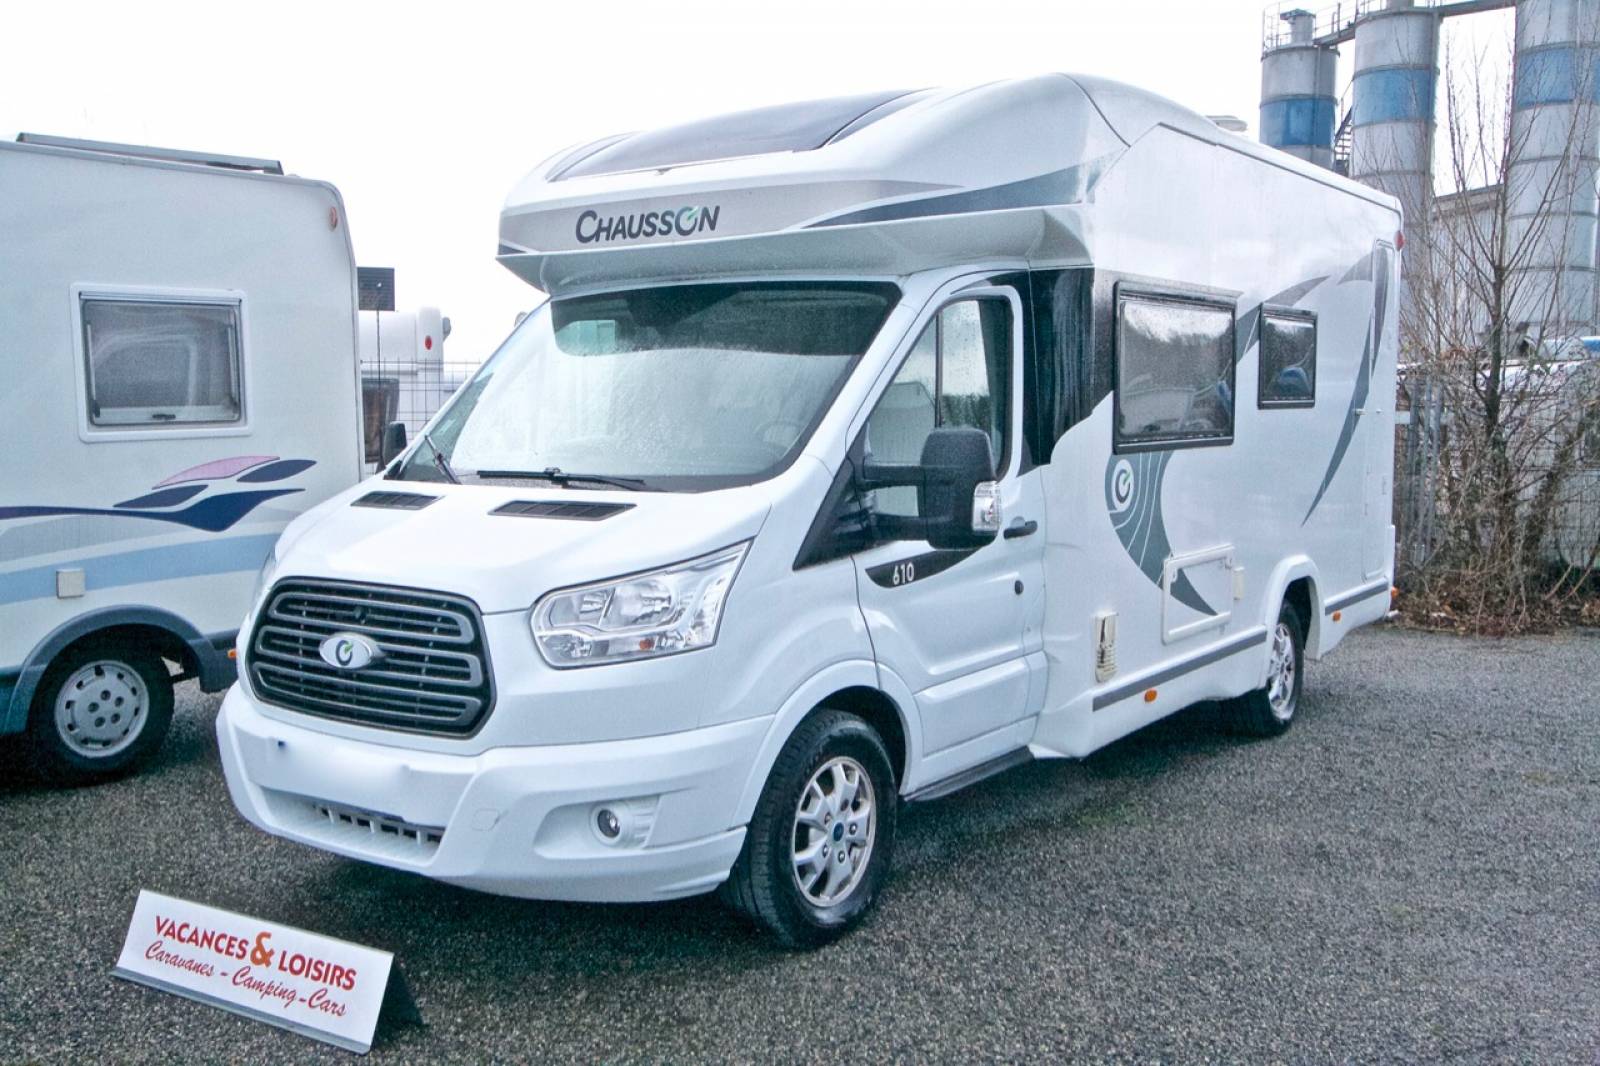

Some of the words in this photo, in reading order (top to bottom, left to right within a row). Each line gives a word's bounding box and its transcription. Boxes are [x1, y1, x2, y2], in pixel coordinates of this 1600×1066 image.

[575, 205, 720, 243] CHAUSSON
[893, 562, 915, 585] 610
[145, 940, 215, 977] Caravanes
[155, 915, 249, 960] VACANCES
[250, 931, 275, 968] &
[278, 950, 357, 991] LOISIRS
